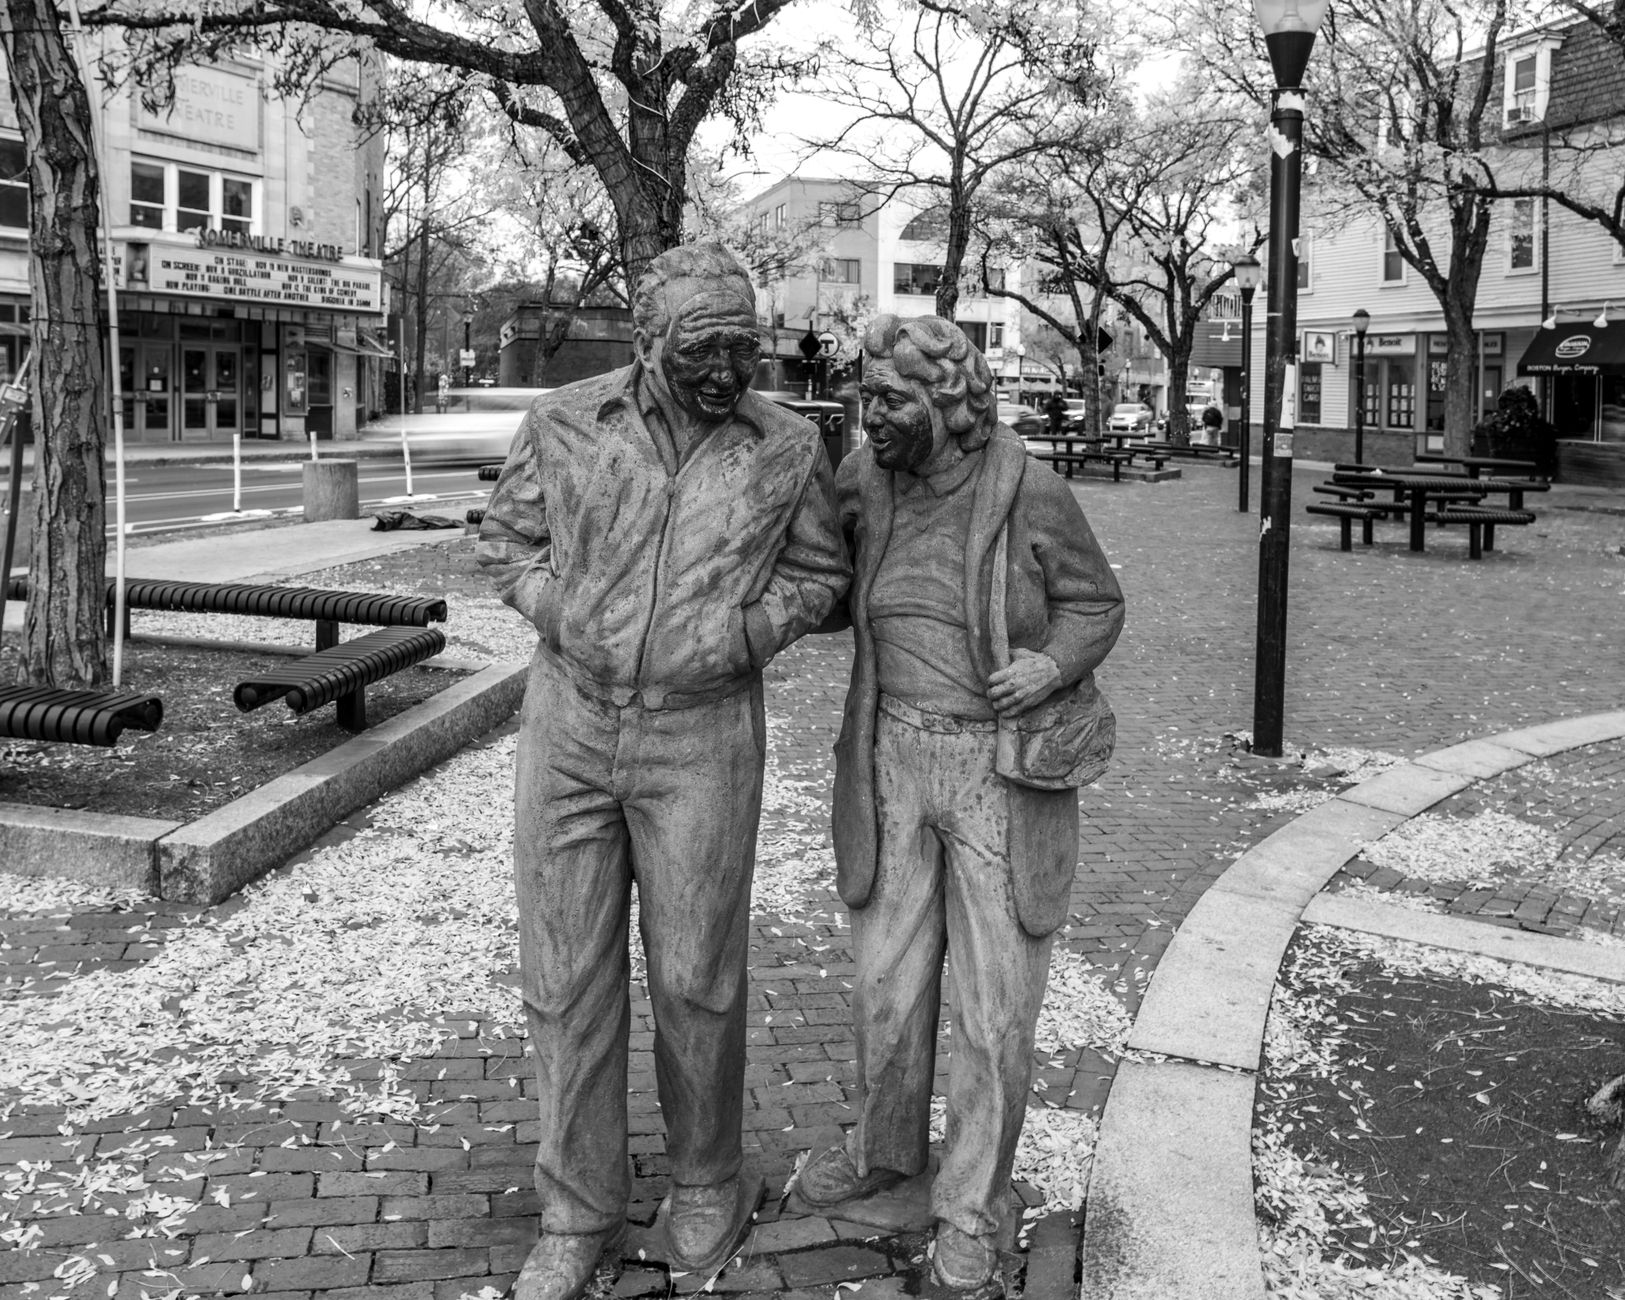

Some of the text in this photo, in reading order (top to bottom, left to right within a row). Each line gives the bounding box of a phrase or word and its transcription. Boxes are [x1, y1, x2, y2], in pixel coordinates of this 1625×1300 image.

[195, 226, 344, 262] SOMERVILLE THEATRE
[161, 260, 171, 269] ON
[206, 265, 217, 274] NOV
[288, 275, 298, 283] NOV
[330, 279, 340, 288] THE
[342, 280, 351, 289] BIG
[352, 282, 371, 291] PARADE
[214, 256, 224, 265] ON
[255, 261, 267, 270] NOV
[277, 263, 289, 273] NEW
[291, 265, 332, 277] MASTERSOUNDS
[165, 280, 179, 289] NOW
[223, 286, 237, 295] ONE
[238, 287, 261, 297] BATTLE
[263, 288, 281, 298] AFTER
[284, 291, 309, 302] ANOTHER
[348, 298, 354, 306] IN
[185, 273, 198, 281] NOV
[208, 274, 230, 285] RAGING
[233, 277, 247, 286] BULL
[282, 282, 292, 291] NOV
[302, 285, 312, 294] THE
[314, 286, 327, 295] KING
[328, 287, 335, 295] OF
[337, 288, 357, 297] COMEDY
[820, 339, 834, 354] T
[1379, 337, 1402, 347] Benoit
[1308, 350, 1329, 359] Benoit
